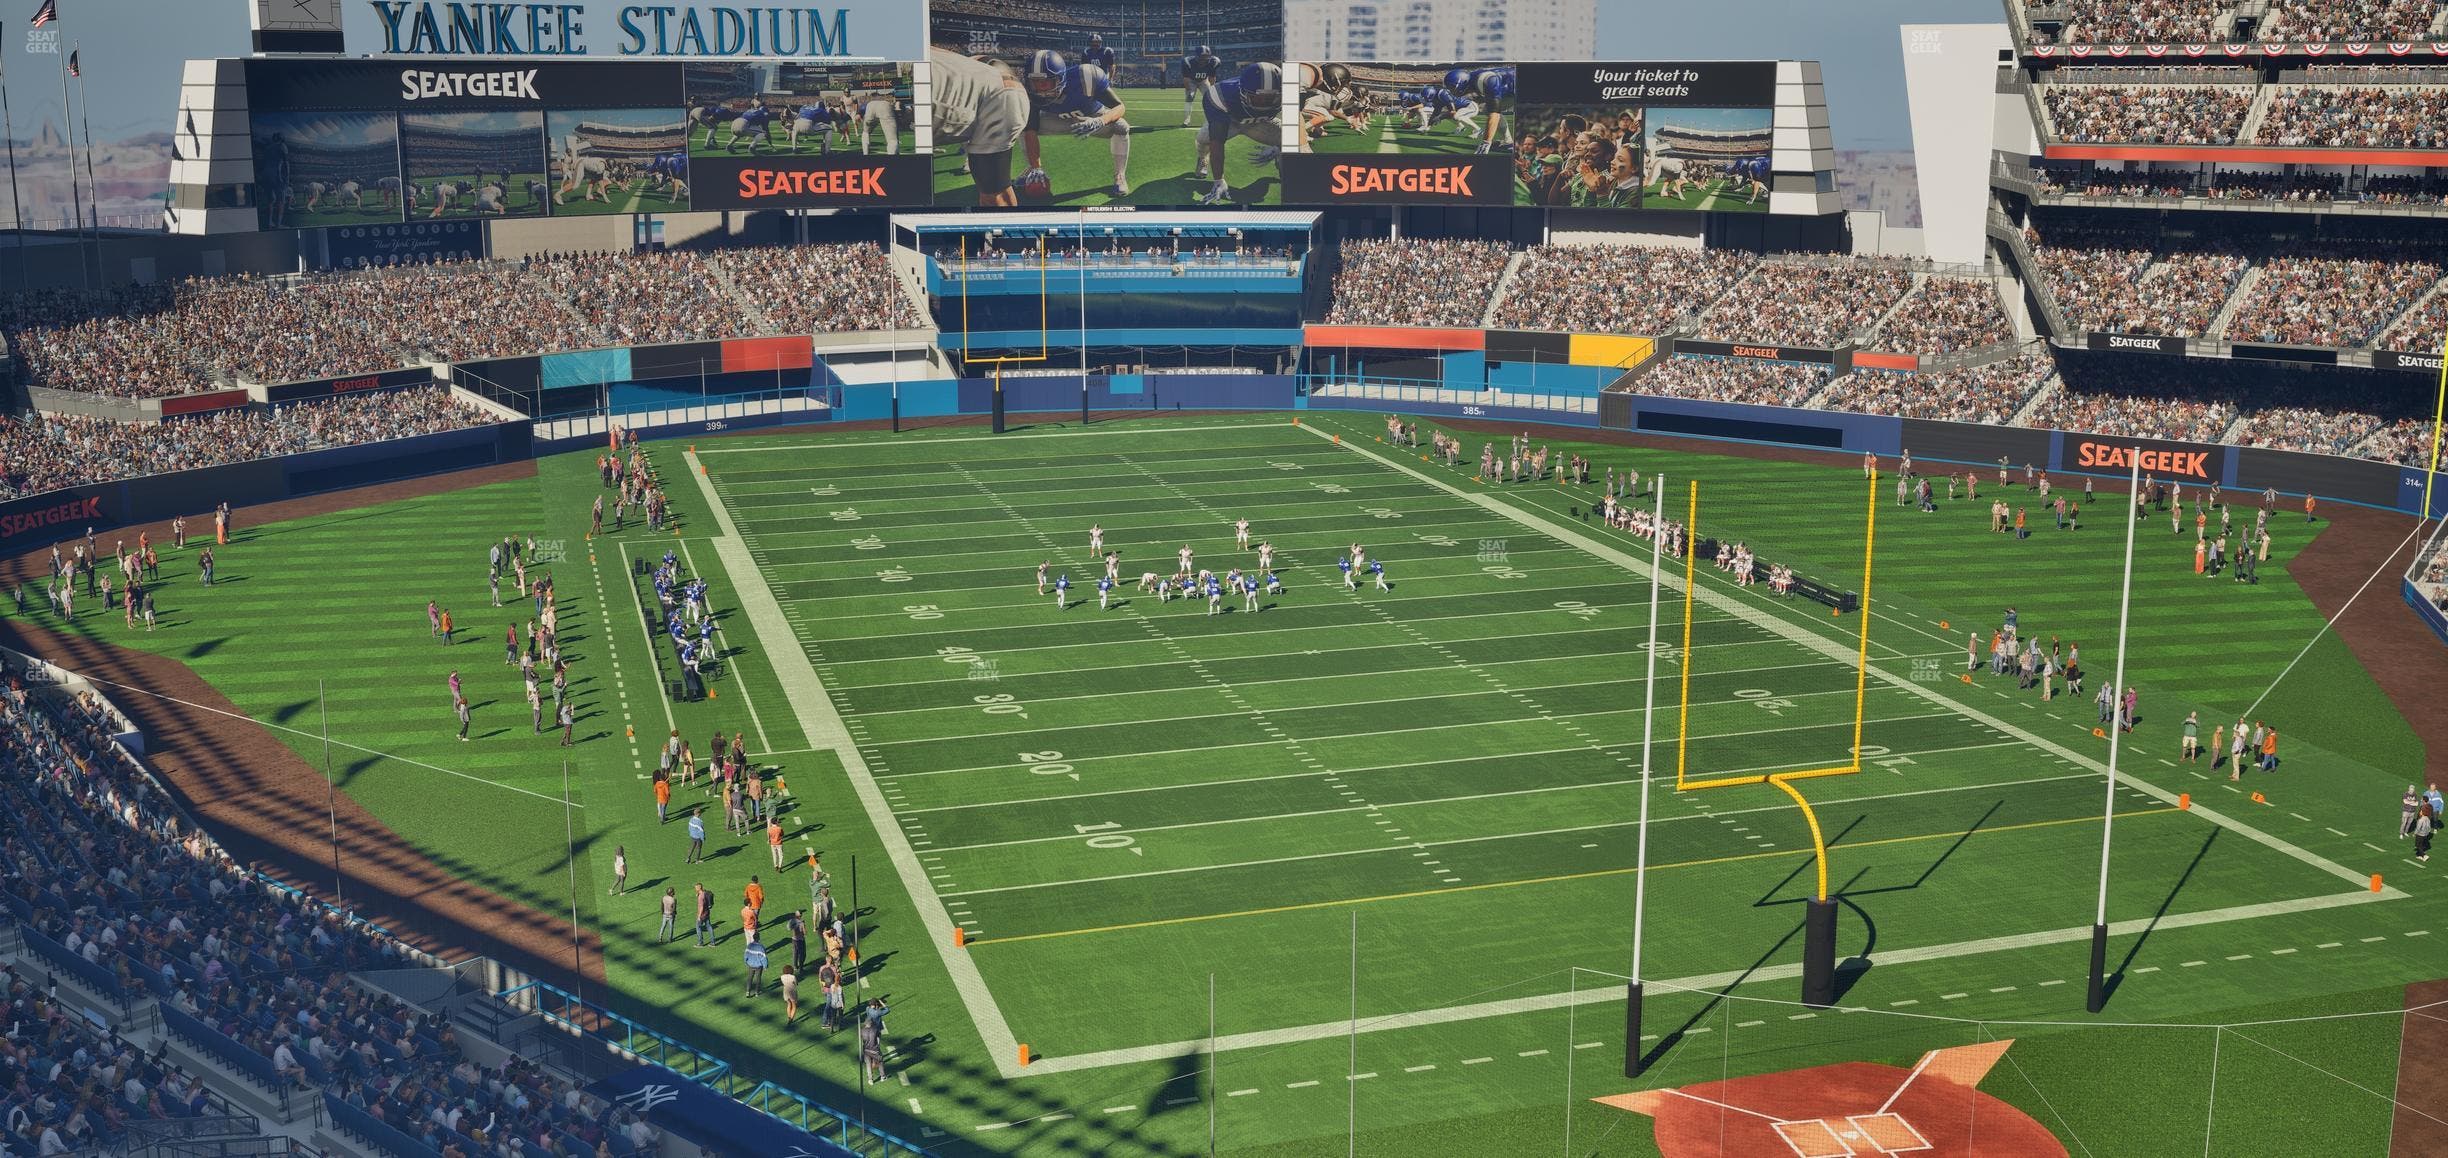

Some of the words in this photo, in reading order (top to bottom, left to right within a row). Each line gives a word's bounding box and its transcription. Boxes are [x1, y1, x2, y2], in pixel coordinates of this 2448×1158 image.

[372, 0, 587, 54] YANKEE
[617, 6, 852, 56] STADIUM
[401, 69, 541, 101] SEATGEEK
[1594, 69, 1631, 83] Your
[1634, 69, 1680, 81] ticket
[1683, 69, 1699, 81] to
[1602, 84, 1645, 100] great
[1647, 84, 1689, 96] seats
[738, 167, 887, 198] SEATGEEK
[1331, 165, 1473, 197] SEATGEEK
[1733, 345, 1779, 360] SEATGEEK
[2110, 336, 2161, 350] SEATGEEK
[2398, 355, 2445, 369] SEATGEE
[332, 376, 380, 394] SEATGEEK
[2078, 442, 2209, 478] SEATGEEK
[0, 496, 102, 538] SEATGEEK
[903, 604, 944, 620] 50
[1553, 601, 1603, 616] 40
[936, 645, 981, 663] 40
[973, 693, 1024, 714] 30
[1733, 688, 1798, 710] 20
[1017, 750, 1074, 775] 20
[1848, 745, 1918, 767] 10
[1073, 821, 1136, 849] 10
